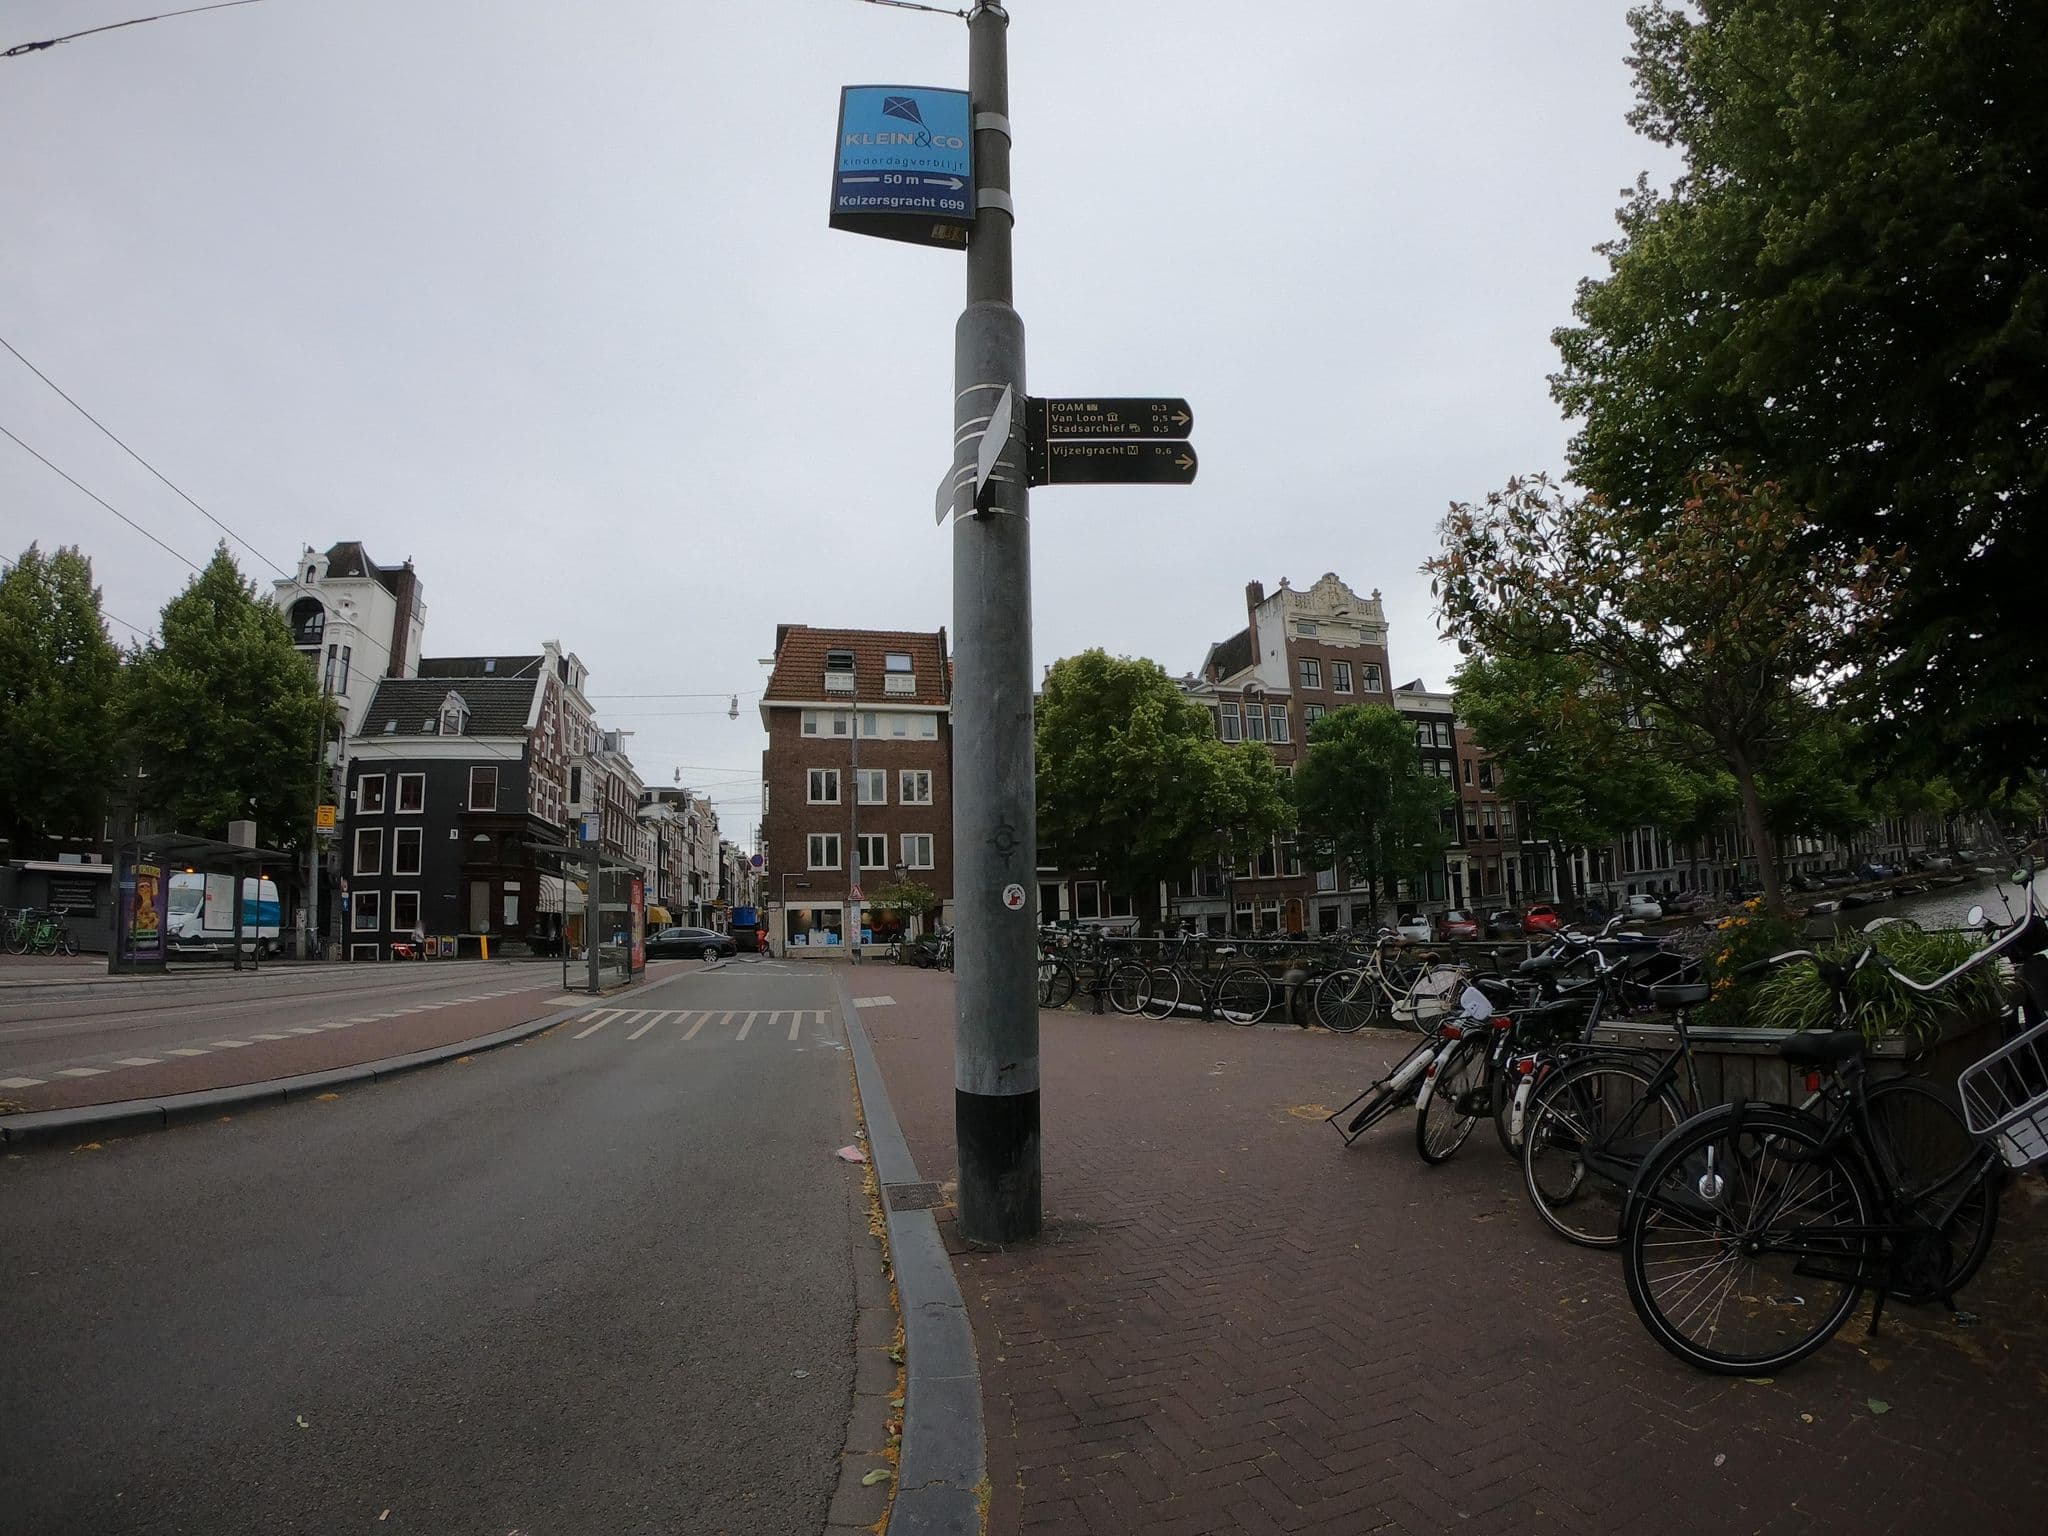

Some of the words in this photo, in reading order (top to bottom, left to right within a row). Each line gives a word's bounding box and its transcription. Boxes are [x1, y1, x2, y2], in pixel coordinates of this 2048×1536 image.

[846, 131, 964, 149] KLEIN&CO
[843, 157, 963, 171] kinderdagverblijf
[883, 174, 903, 185] 50
[905, 175, 920, 185] m
[839, 195, 937, 208] Keizersgracht
[939, 199, 965, 210] 699
[1051, 403, 1084, 412] FOAM
[1051, 414, 1073, 423] Van
[1076, 414, 1104, 422] Loon
[1051, 423, 1126, 433] Stadsarchief
[1052, 445, 1125, 457] Vijzelgracht
